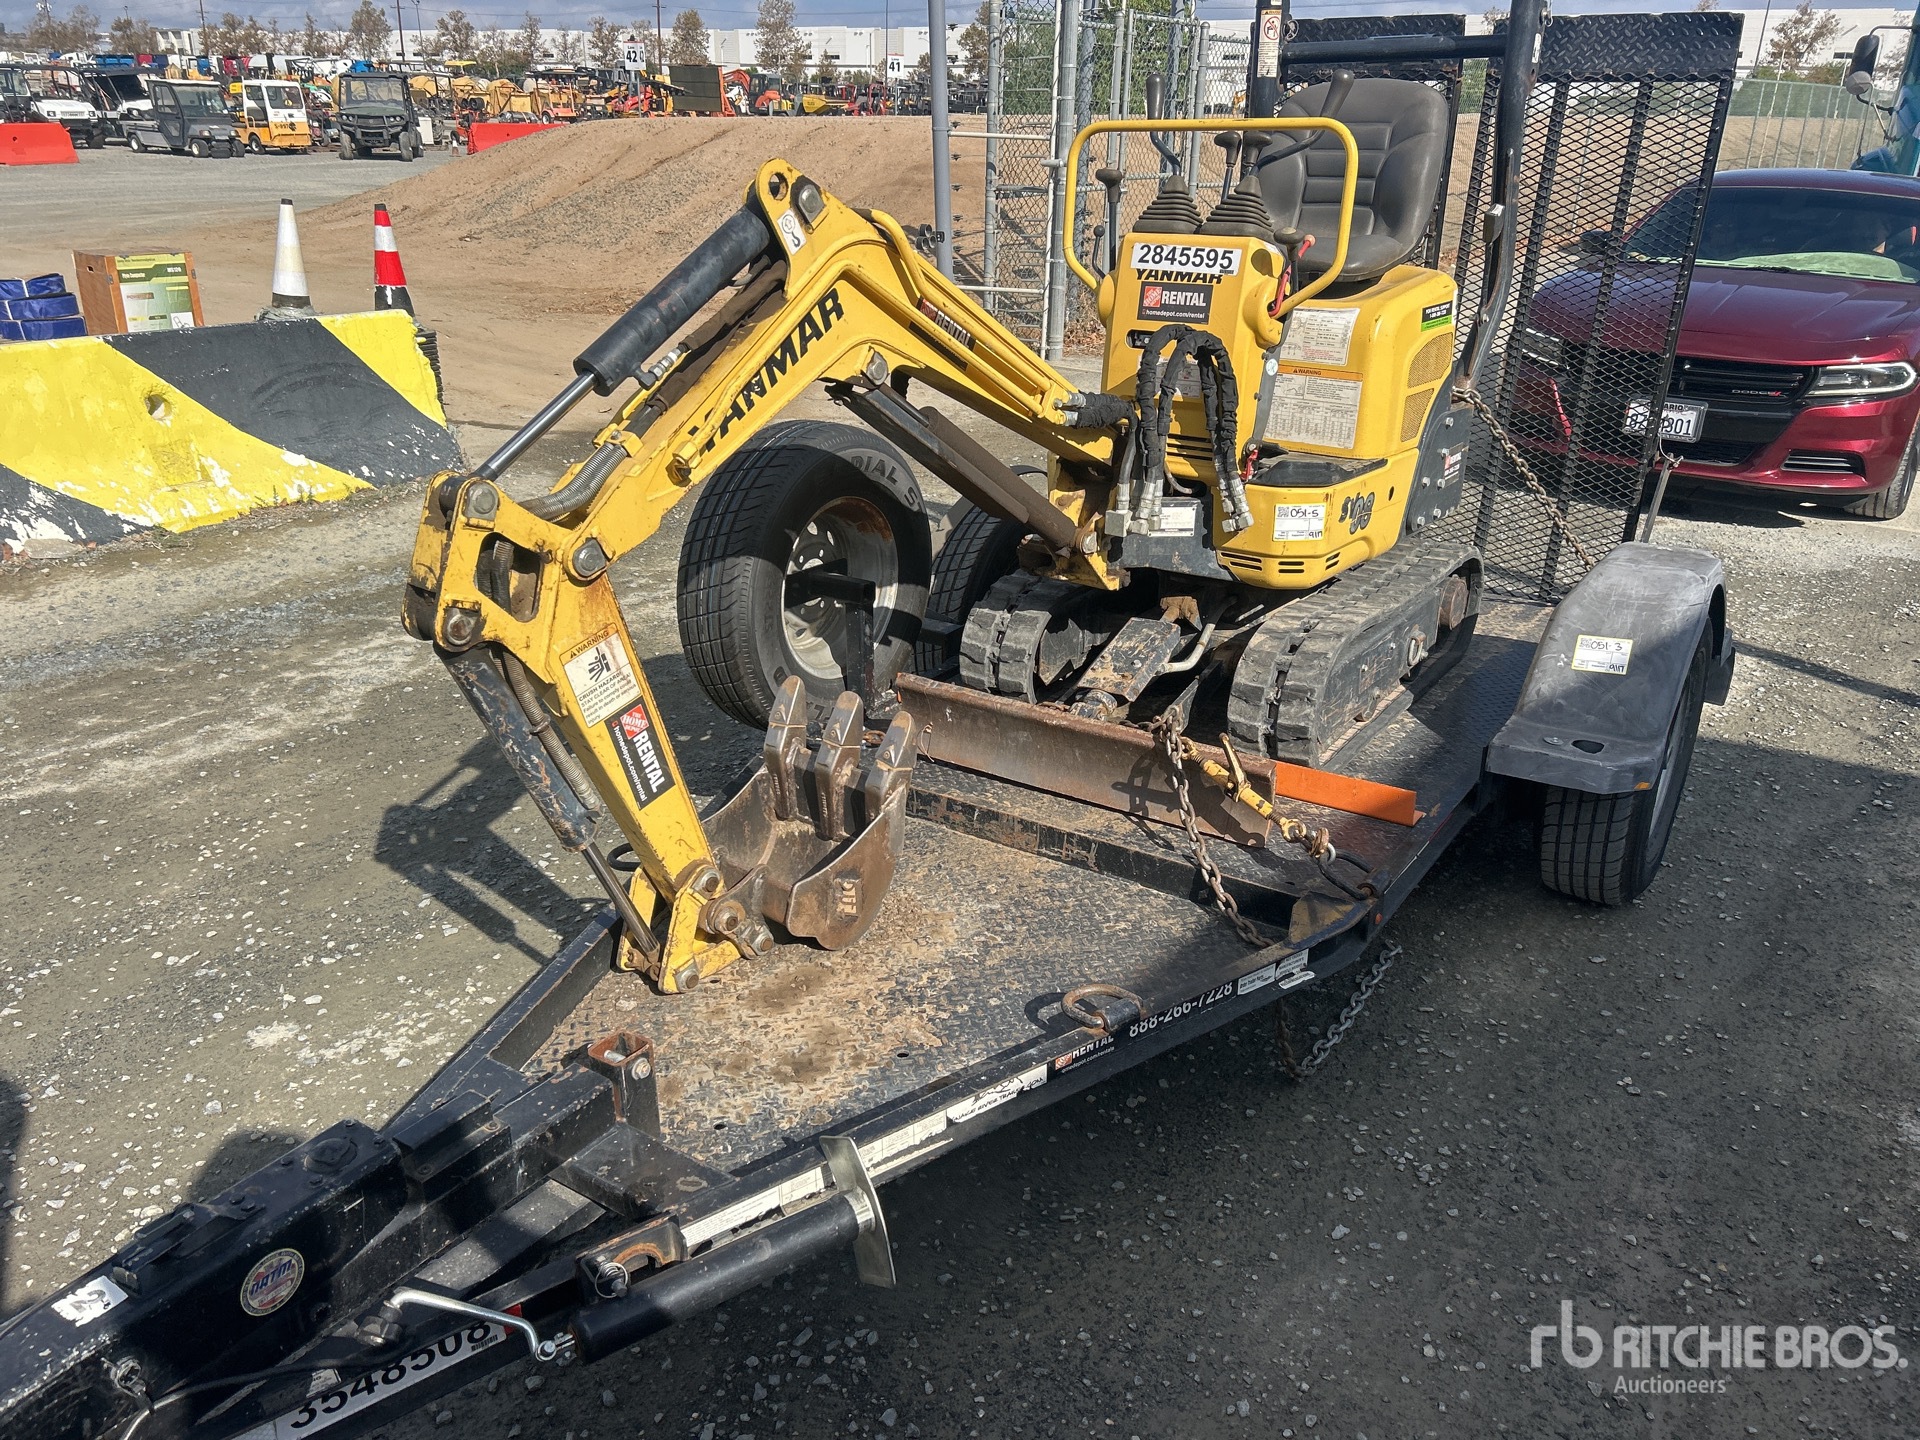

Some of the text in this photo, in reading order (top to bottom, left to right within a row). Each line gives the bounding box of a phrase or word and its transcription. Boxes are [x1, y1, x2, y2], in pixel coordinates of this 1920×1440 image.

[626, 51, 638, 63] 42
[889, 61, 901, 72] 41
[1138, 244, 1234, 270] 2845595
[1136, 268, 1223, 284] YANMAR
[1161, 290, 1206, 307] RENTAL
[1145, 309, 1205, 319] homedepot.com/rental
[935, 310, 971, 348] RENTAL
[851, 455, 898, 485] DIAL
[575, 630, 609, 654] WARNING
[579, 688, 598, 702] CRUSH
[581, 697, 594, 708] STAY
[593, 687, 610, 700] CLEAR
[621, 714, 646, 729] HOME
[614, 725, 647, 802] homedepot.com/rental
[633, 730, 665, 793] RENTAL
[291, 1321, 491, 1429] 3548508
